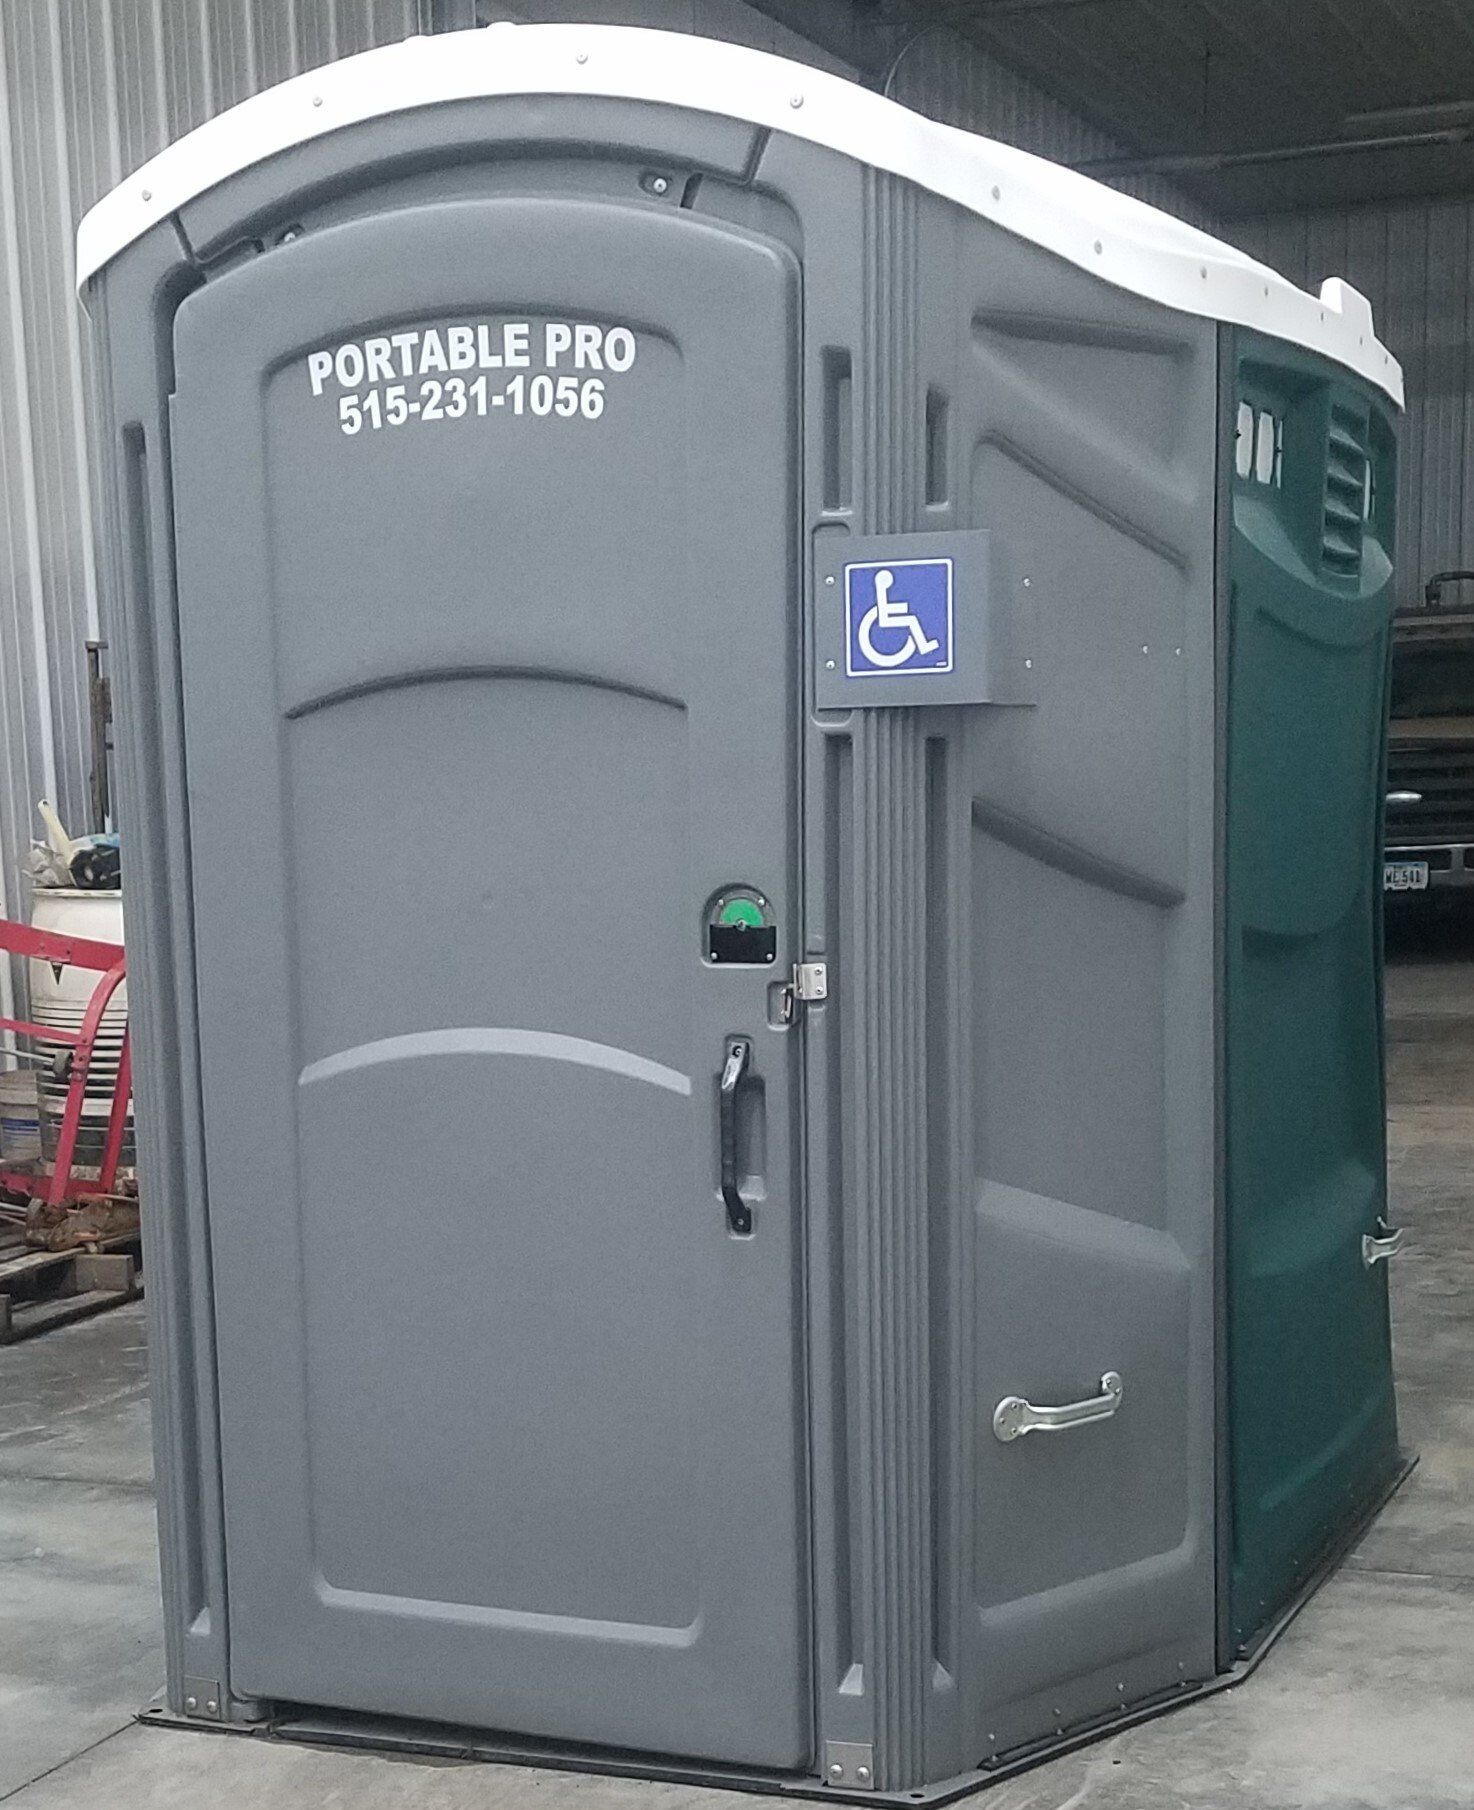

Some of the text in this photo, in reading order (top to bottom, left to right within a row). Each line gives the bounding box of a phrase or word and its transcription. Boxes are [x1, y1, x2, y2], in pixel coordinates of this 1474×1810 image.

[307, 323, 636, 396] PORTABLE PRO
[338, 375, 605, 435] 515-231-1056
